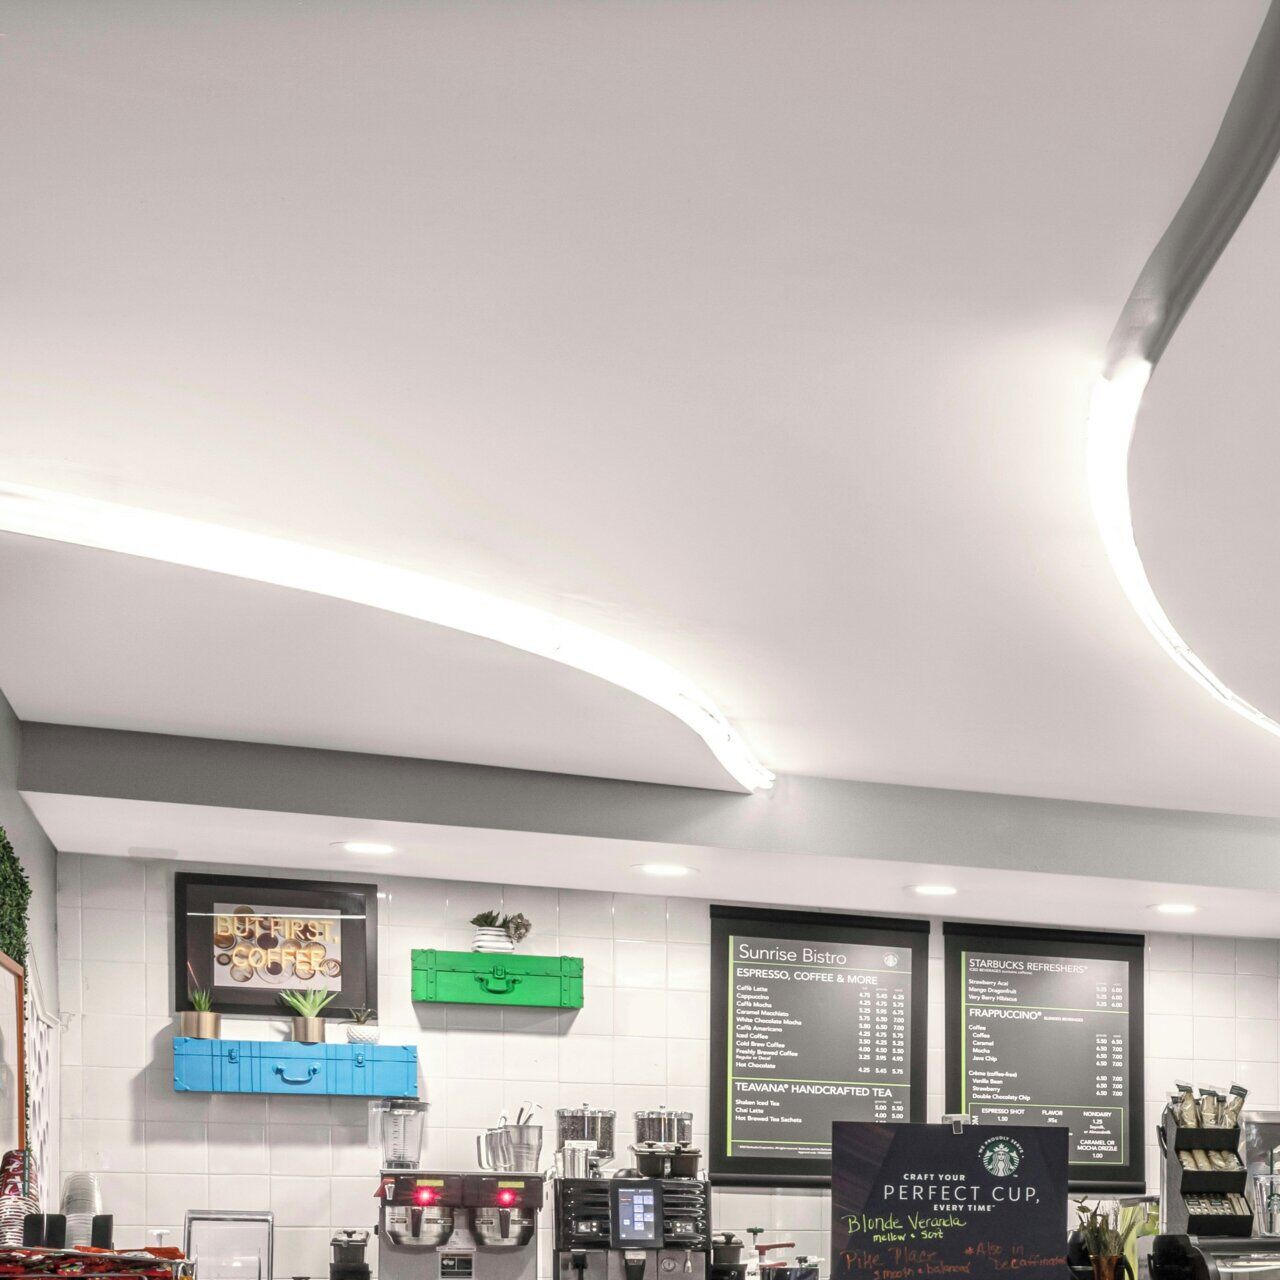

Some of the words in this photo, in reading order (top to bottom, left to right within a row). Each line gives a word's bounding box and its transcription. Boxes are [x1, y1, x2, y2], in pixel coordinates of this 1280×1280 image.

[217, 916, 265, 938] BUT
[739, 943, 797, 961] Sunrise
[802, 948, 847, 965] Bistro
[232, 948, 325, 971] COFFEE
[969, 958, 1024, 970] STARBUCKS
[736, 967, 791, 982] ESPRESSO,
[793, 971, 834, 983] COFFEE
[835, 974, 845, 983] &
[847, 975, 878, 986] MORE
[736, 993, 770, 1002] Cappuccino
[736, 1008, 760, 1016] Caramel
[761, 1009, 790, 1018] Macchiato
[736, 1016, 753, 1024] White
[754, 1017, 781, 1026] Chocolate
[782, 1019, 802, 1027] Mocha
[750, 1033, 769, 1041] Coffee
[736, 1040, 750, 1048] Cold
[767, 1042, 786, 1050] Coffee
[972, 1039, 995, 1047] Caramel
[736, 1048, 756, 1058] Freshly
[756, 1049, 779, 1057] Brewed
[791, 1085, 869, 1098] HANDCRAFTED
[872, 1087, 892, 1099] TEA
[1041, 1109, 1064, 1117] FLAVOR
[903, 1173, 935, 1182] CRAFT
[938, 1173, 967, 1182] YOUR
[883, 1185, 981, 1201] PERFECT
[991, 1186, 1040, 1204] CUP,
[933, 1204, 965, 1212] EVERY
[842, 1213, 904, 1234] Blonde
[908, 1211, 967, 1230] Veranda
